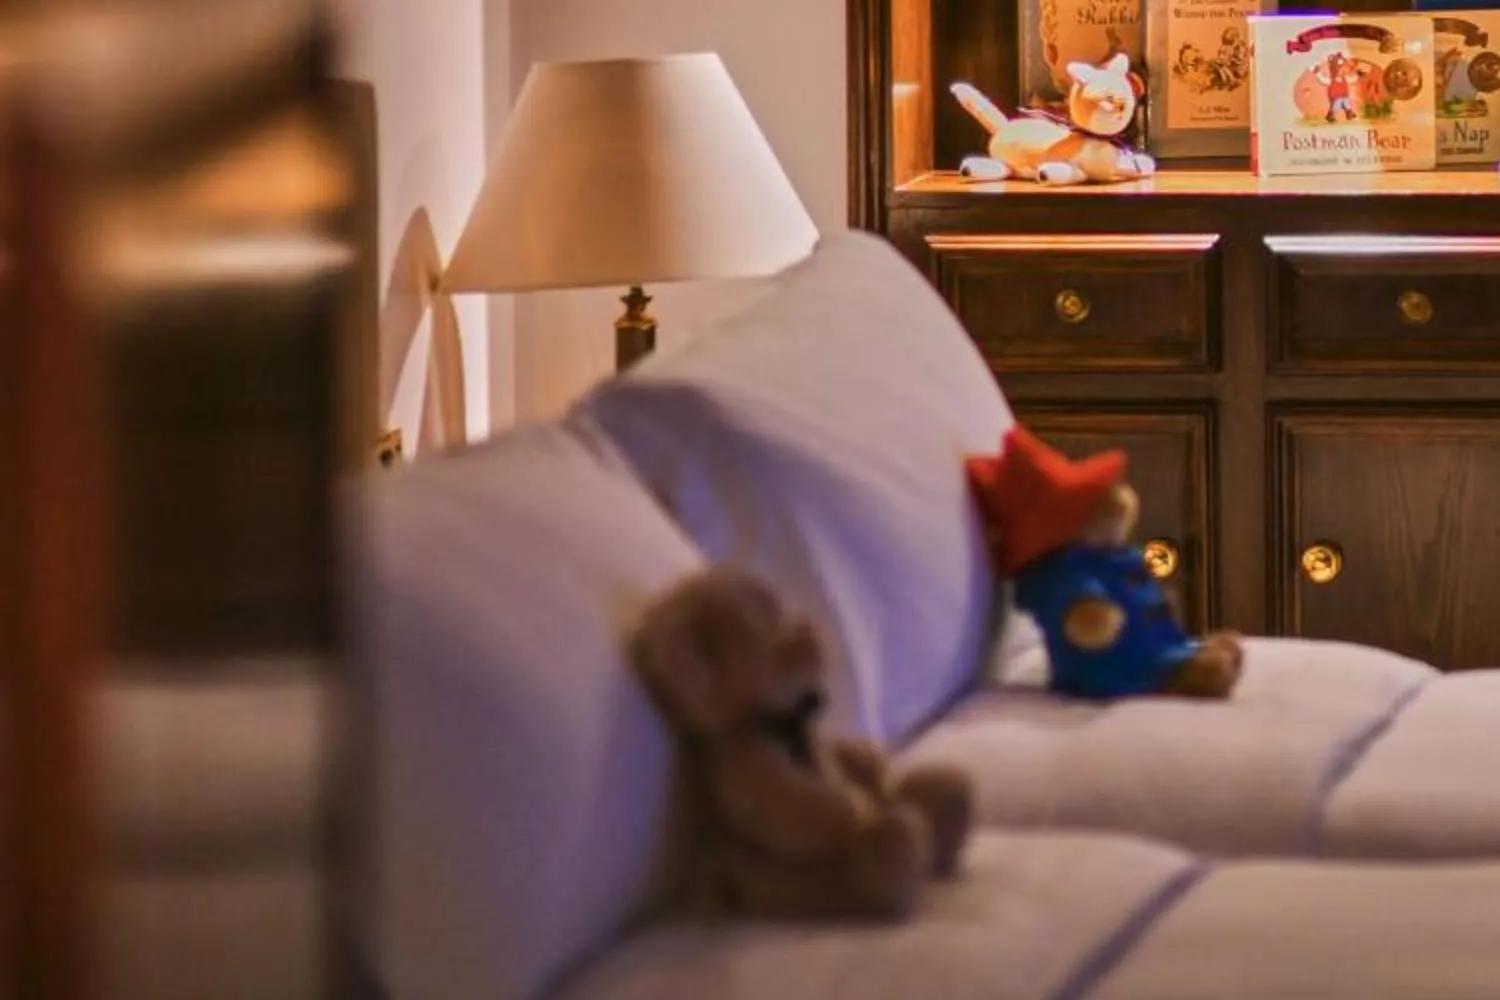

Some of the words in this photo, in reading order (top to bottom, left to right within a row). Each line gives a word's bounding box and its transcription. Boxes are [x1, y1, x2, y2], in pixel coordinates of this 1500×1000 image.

[1282, 130, 1361, 151] Postman
[1366, 128, 1412, 149] Bear
[1454, 120, 1490, 149] Nap
